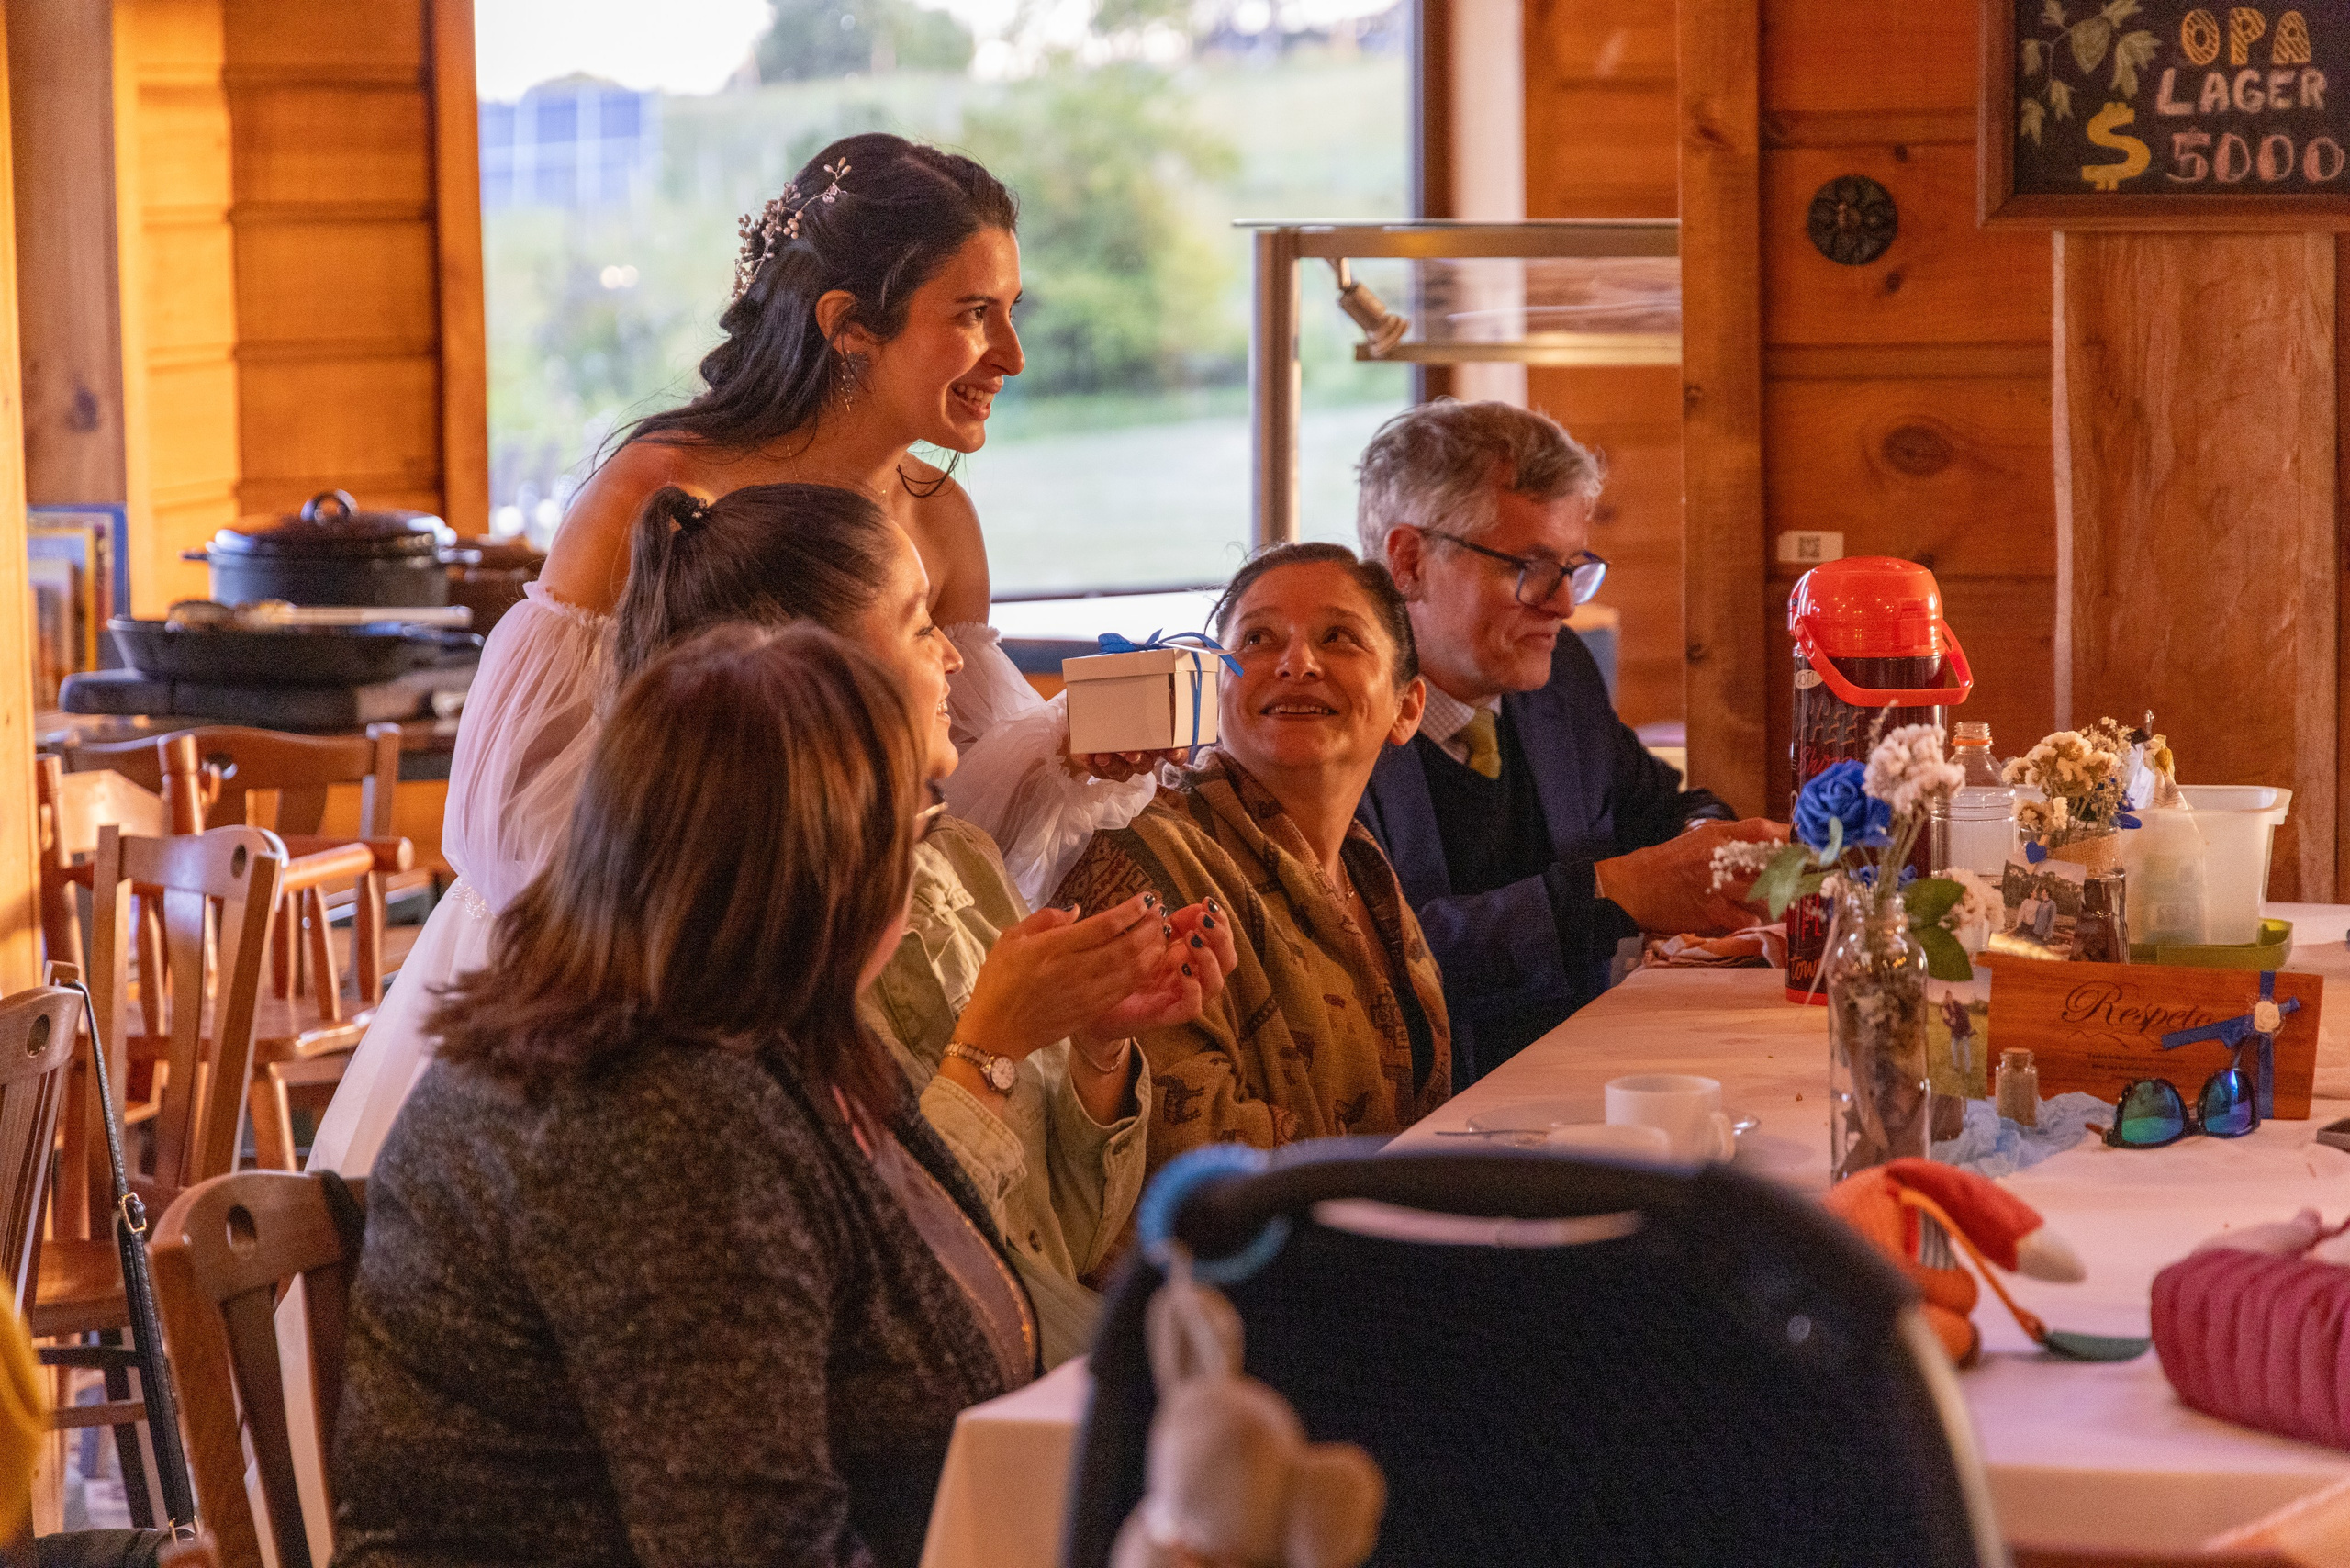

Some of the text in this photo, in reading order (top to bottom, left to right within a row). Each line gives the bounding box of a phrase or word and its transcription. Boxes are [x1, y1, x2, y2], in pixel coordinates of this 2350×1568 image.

[2180, 6, 2312, 66] OPA
[2155, 67, 2328, 116] LAGER
[2166, 127, 2346, 183] 5000
[2061, 980, 2214, 1034] Respeto
